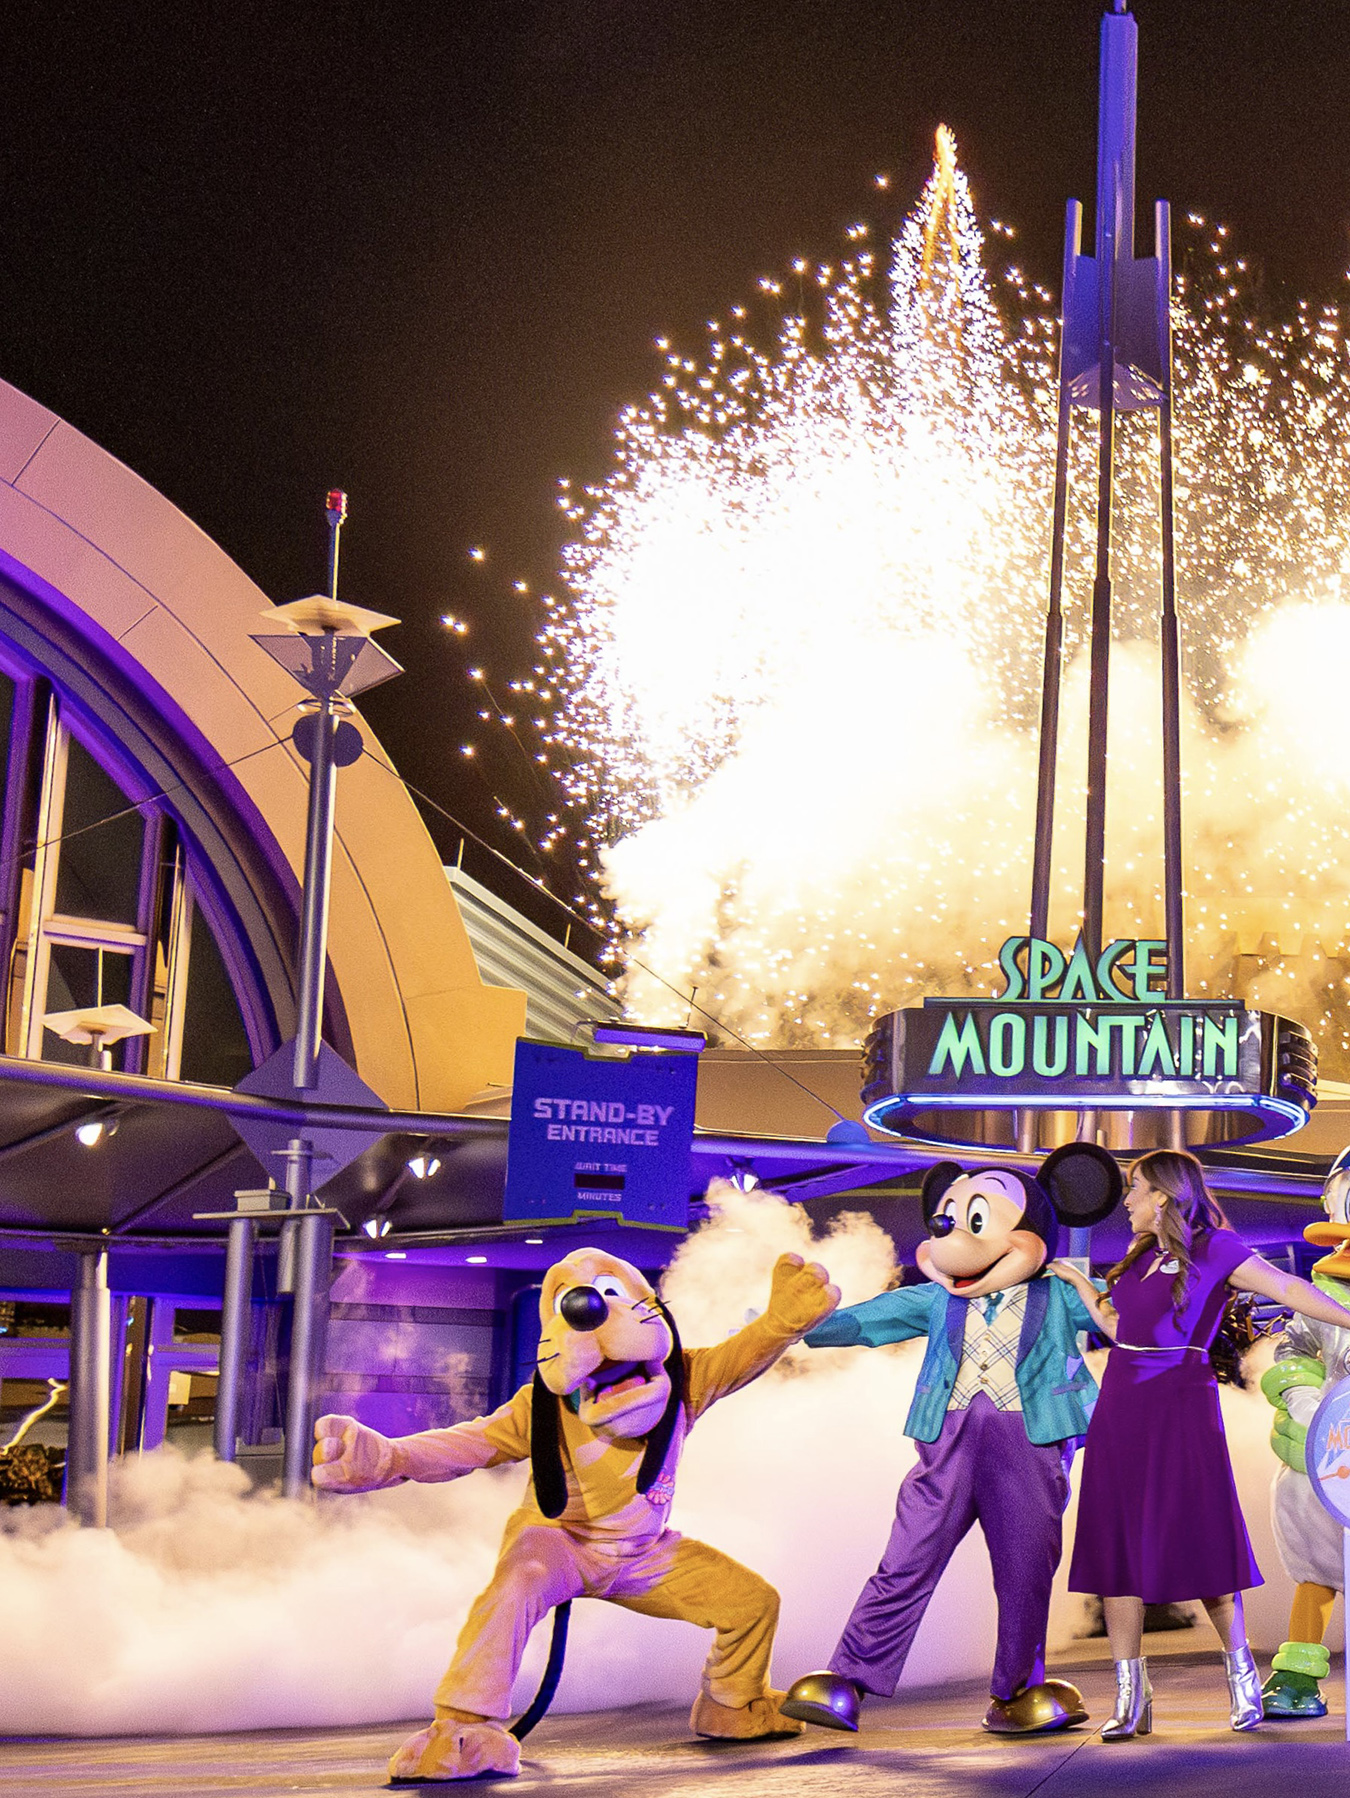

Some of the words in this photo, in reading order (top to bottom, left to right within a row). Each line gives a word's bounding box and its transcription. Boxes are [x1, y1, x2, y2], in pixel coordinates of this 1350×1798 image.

[999, 928, 1169, 1001] SPACE
[928, 1010, 1238, 1079] MOUNTAIN
[533, 1097, 675, 1126] STAND-BY
[546, 1124, 660, 1147] ENTRANCE
[577, 1191, 622, 1202] MINUTES
